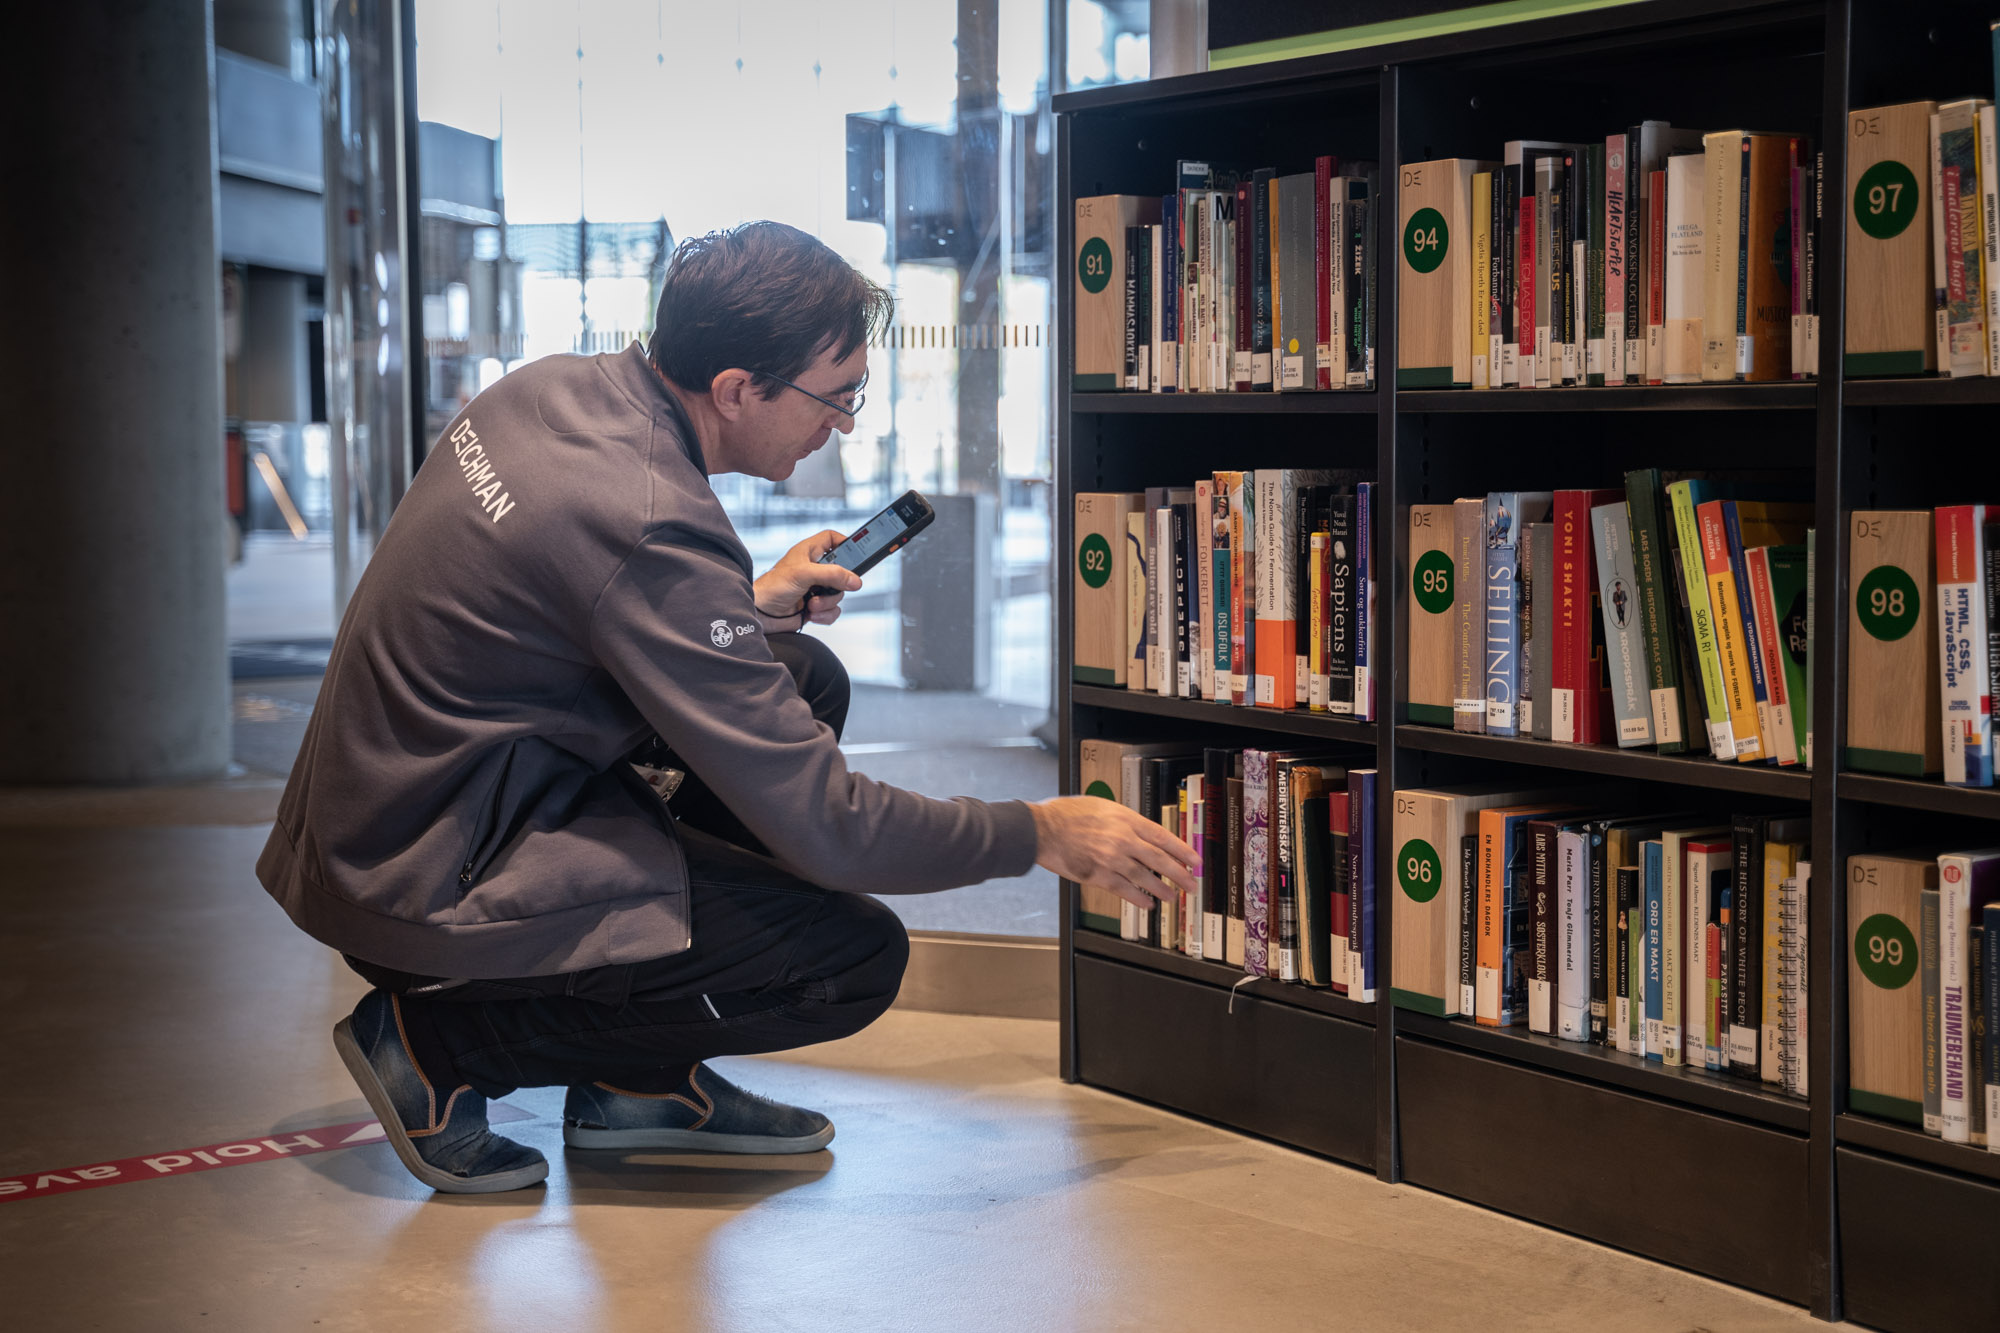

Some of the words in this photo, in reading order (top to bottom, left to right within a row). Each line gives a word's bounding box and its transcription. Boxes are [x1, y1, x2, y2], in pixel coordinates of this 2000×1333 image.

[1854, 116, 1880, 137] DE
[1868, 183, 1904, 215] 97
[1628, 210, 1638, 236] UNG
[1947, 183, 1961, 254] malerens
[1961, 197, 1977, 248] LINNEA
[1414, 227, 1439, 252] 94
[1477, 233, 1485, 259] Vigdis
[1551, 229, 1560, 256] THIS
[1607, 191, 1624, 276] HEARTSTOPPER
[1086, 254, 1104, 275] 91
[1354, 245, 1363, 275] ŽIŽEK
[1551, 259, 1560, 270] IS
[1628, 238, 1638, 282] VOKSEN
[1738, 250, 1746, 280] MUSIKK
[1477, 261, 1485, 288] Hjorth
[1492, 257, 1501, 316] Forbannelsen
[1551, 273, 1560, 291] US
[1738, 283, 1745, 293] OG
[1806, 253, 1814, 300] Christmas
[1478, 290, 1485, 298] Er
[1628, 284, 1638, 302] OG
[450, 418, 516, 523] DEICHMAN
[1414, 512, 1431, 528] DE
[1564, 510, 1573, 555] YONI
[1857, 520, 1882, 539] DE
[1463, 537, 1471, 560] Daniel
[1603, 517, 1613, 561] SCHJERVEN
[1640, 529, 1650, 552] LARS
[1704, 516, 1716, 560] LEKSEHJELPEN
[1714, 537, 1722, 551] store
[1086, 549, 1105, 571] 92
[1269, 548, 1274, 556] to
[1200, 546, 1208, 607] FOLKERETT
[1423, 569, 1448, 593] 95
[1463, 562, 1471, 582] Miller
[1642, 553, 1653, 583] ROEDE
[1358, 577, 1366, 595] Søtt
[1563, 562, 1573, 628] SHAKTI
[1717, 581, 1728, 617] Matematikk,
[1944, 589, 1953, 607] and
[1149, 594, 1156, 608] av
[1331, 564, 1350, 652] Sapiens
[1357, 597, 1365, 609] og
[1463, 602, 1471, 620] The
[1646, 587, 1658, 633] HISTORISK
[1870, 588, 1905, 617] 98
[1956, 588, 1970, 633] HTML,
[735, 624, 755, 636] Oslo
[1218, 612, 1228, 662] OSLOFOLK
[1358, 611, 1366, 657] sukkerfritt
[1487, 565, 1511, 703] SEILING
[1695, 609, 1709, 640] SIGMA
[1721, 619, 1731, 641] engelsk
[1463, 622, 1471, 656] Comfort
[1651, 636, 1661, 663] ATLAS
[1701, 642, 1711, 653] R1
[1944, 609, 1958, 689] JavaScript
[1463, 657, 1471, 669] of
[1727, 651, 1735, 666] norsk
[1746, 622, 1762, 685] LYDJOURNALISTIKK
[1958, 638, 1970, 675] CSS,
[1619, 631, 1636, 711] KROPPSSPRÅK
[1654, 665, 1664, 688] OVER
[1461, 671, 1471, 699] Things
[1730, 678, 1742, 711] FORELDRE
[1278, 770, 1287, 862] MEDIEVITENSKAP
[1485, 834, 1491, 845] EN
[1536, 834, 1545, 851] LARS
[1351, 854, 1359, 880] Norsk
[1407, 857, 1432, 883] 96
[1536, 853, 1545, 885] MYTTING
[1739, 844, 1748, 869] THE
[1592, 860, 1600, 907] STJERNER
[1853, 865, 1878, 885] DE
[1739, 872, 1748, 923] HISTORY
[1350, 900, 1359, 950] andrespråk
[1593, 910, 1600, 925] OG
[1649, 900, 1659, 926] ORD
[1649, 929, 1659, 944] ER
[1739, 927, 1747, 943] OF
[1989, 930, 1997, 961] PILGRIM
[1869, 935, 1903, 965] 99
[1649, 948, 1659, 983] MAKT
[1738, 947, 1747, 986] WHITE
[1990, 964, 1997, 976] AT
[1666, 975, 1672, 989] OG
[1990, 978, 1998, 1005] TINKER
[1737, 991, 1747, 1027] PEOPL
[1945, 985, 1963, 1101] TRAUMEBEHAND
[142, 1134, 325, 1174] Hold
